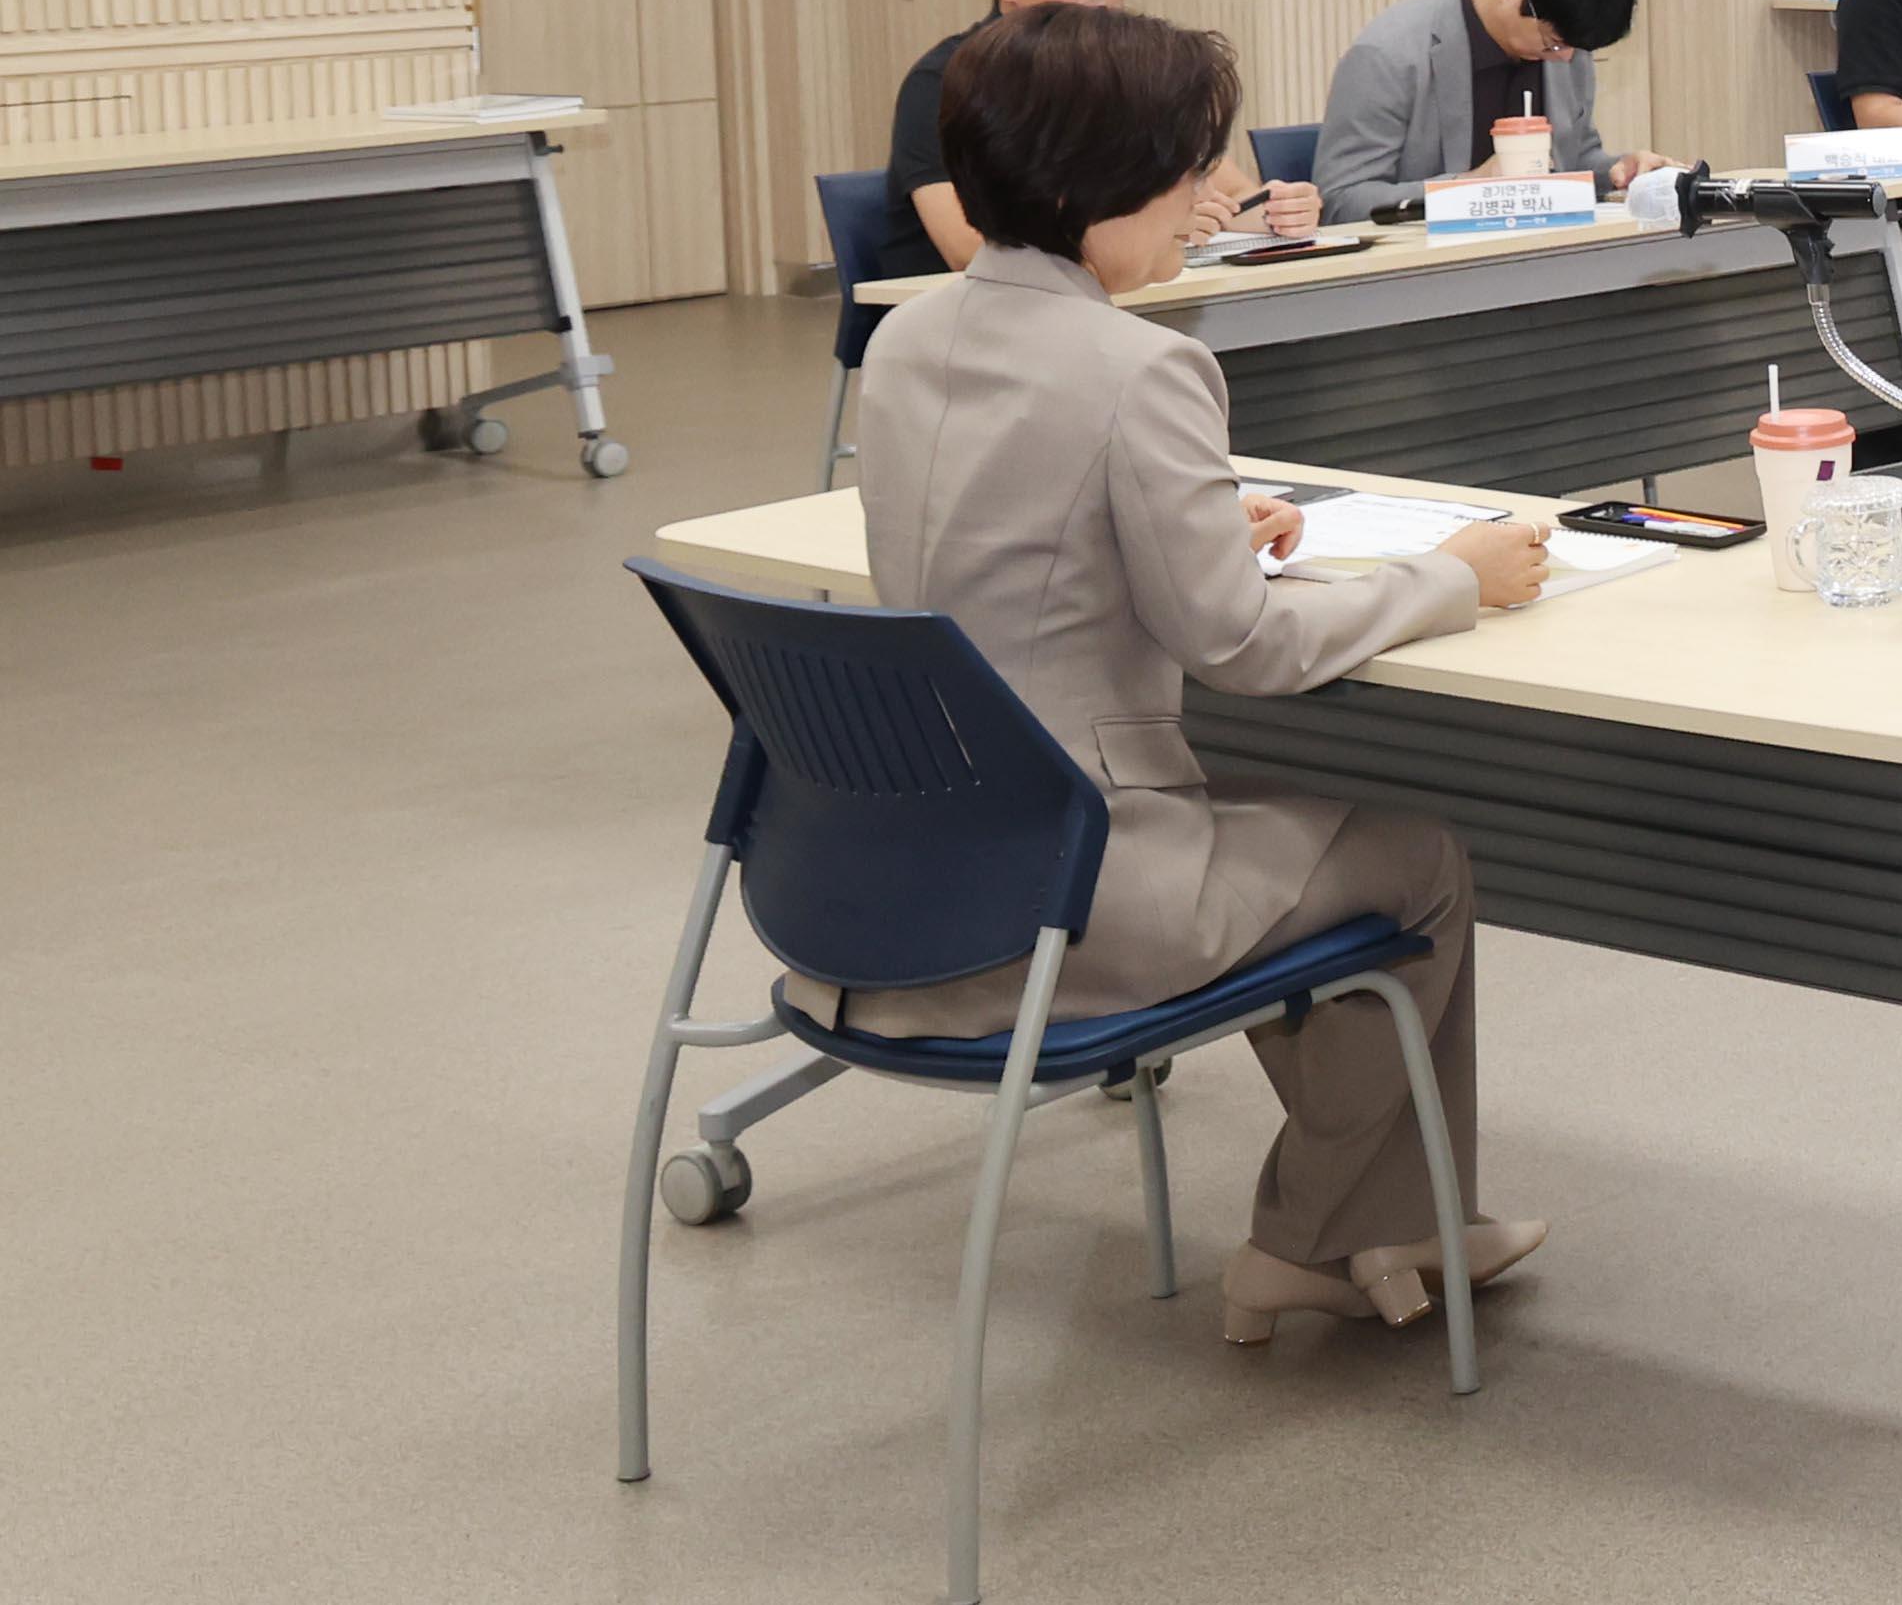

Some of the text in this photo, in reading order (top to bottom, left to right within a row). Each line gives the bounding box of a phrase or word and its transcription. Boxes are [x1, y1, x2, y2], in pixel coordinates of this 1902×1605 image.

[1481, 183, 1541, 199] 경기연구원
[1469, 196, 1553, 217] 김병관 박사
